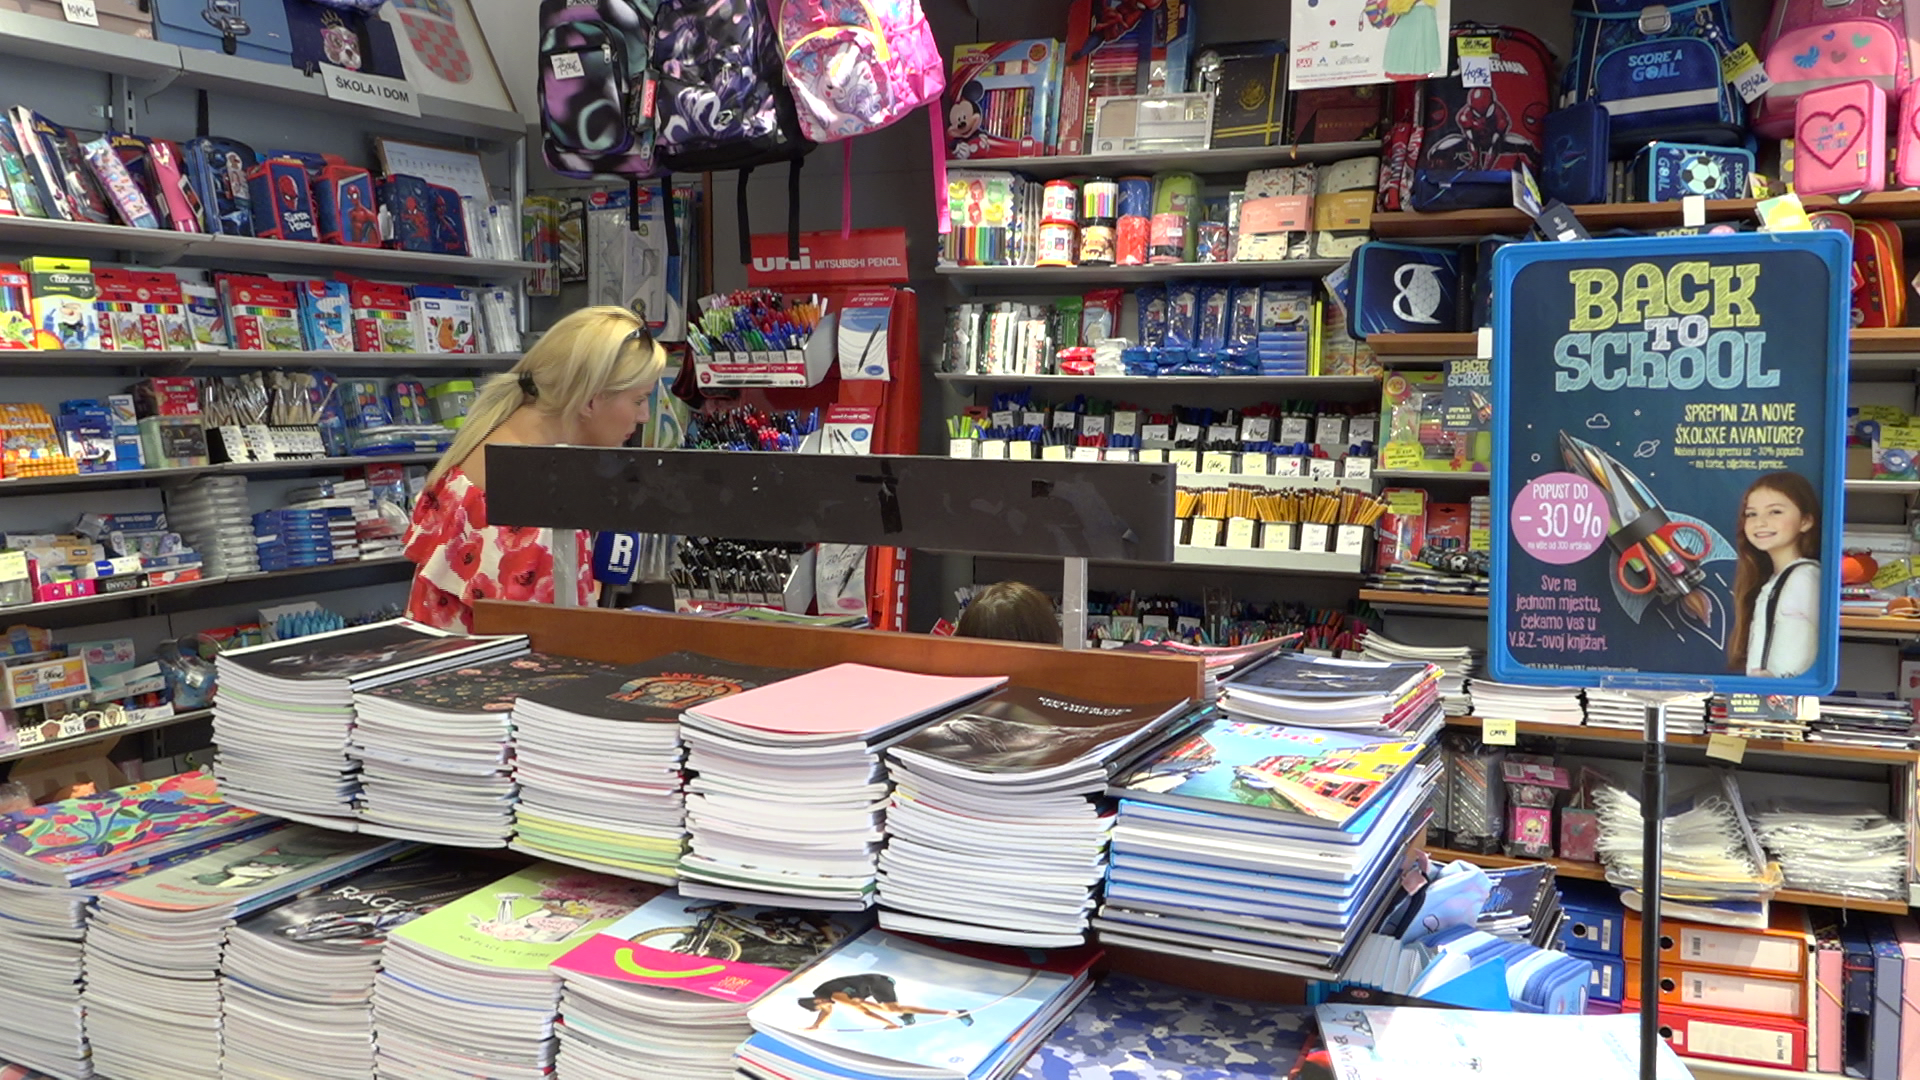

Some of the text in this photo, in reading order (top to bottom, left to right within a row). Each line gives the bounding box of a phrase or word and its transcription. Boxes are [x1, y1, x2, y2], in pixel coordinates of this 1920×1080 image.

[1628, 49, 1682, 67] SCORE A
[1632, 62, 1680, 82] GOAL
[336, 75, 409, 103] ŠKOLA I DOM
[1734, 162, 1744, 188] SCORE
[288, 221, 312, 232] HERO
[753, 247, 901, 272] uni MITSUBISHI PENCIL
[1569, 261, 1760, 331] BACK
[1644, 314, 1709, 350] TO
[1451, 360, 1489, 375] BACK
[1684, 403, 1796, 422] SPREMNI ZA NOVE
[1675, 423, 1804, 444] ŠKOLSKE AVANTURE?
[1533, 483, 1588, 499] POPUST DO
[610, 533, 634, 567] R
[1541, 575, 1576, 591] Sve na
[1516, 594, 1601, 613] jednom mjestu,
[1521, 613, 1596, 631] čekamo vas u
[1567, 633, 1608, 653] knjižari.
[334, 886, 413, 913] RACE
